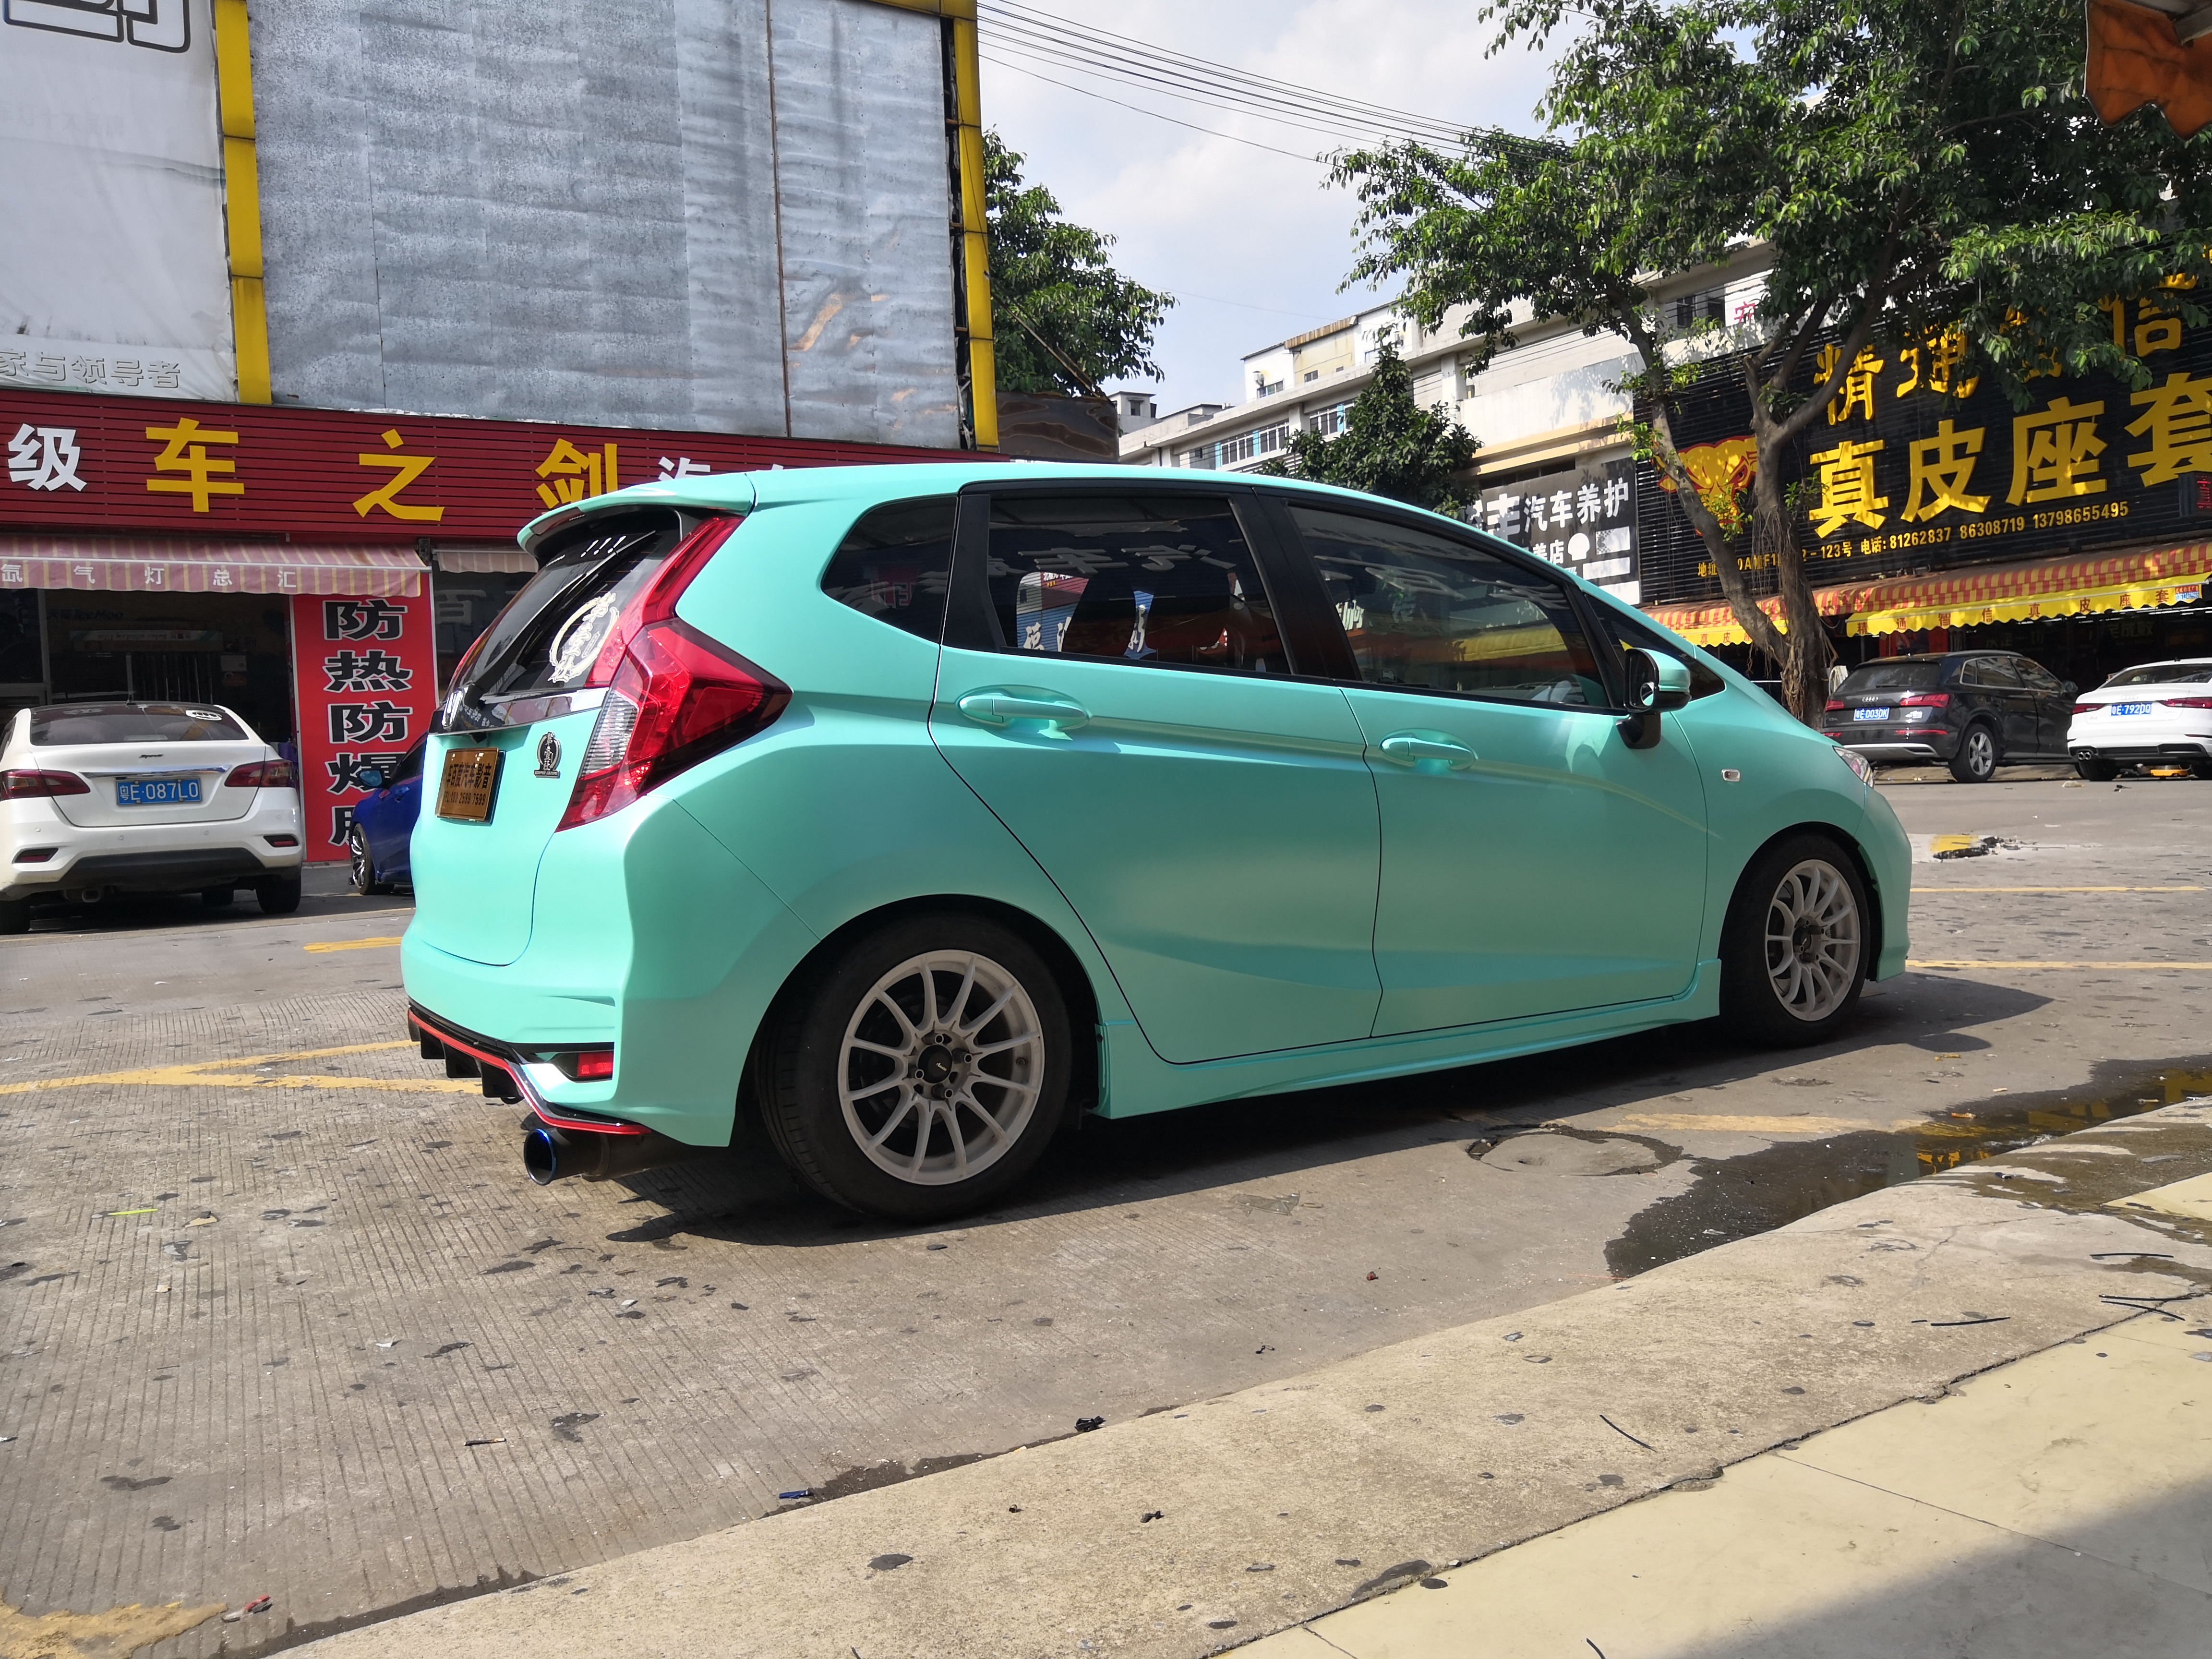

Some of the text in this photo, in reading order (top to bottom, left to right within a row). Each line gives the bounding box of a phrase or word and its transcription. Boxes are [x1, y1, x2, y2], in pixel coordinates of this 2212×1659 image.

[1809, 373, 2212, 539] 真皮座套
[1960, 516, 2025, 540] 86308719
[2033, 501, 2129, 529] 13798655495
